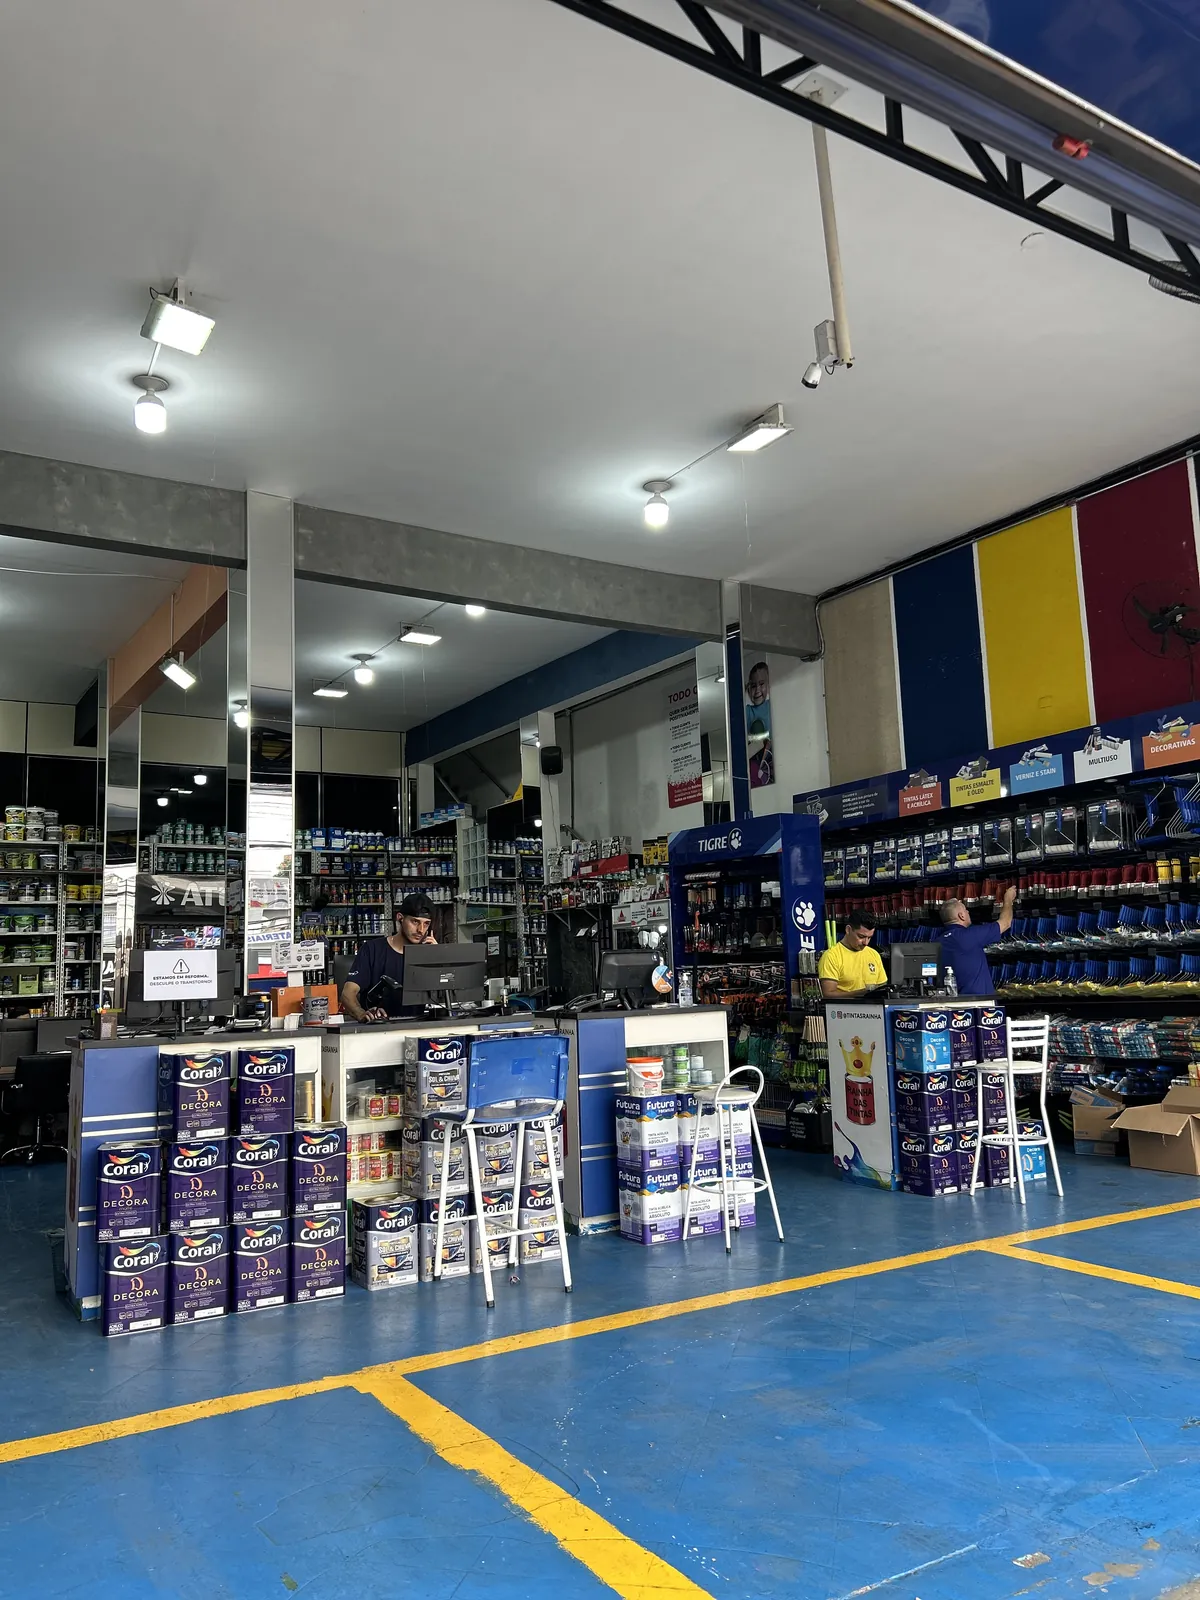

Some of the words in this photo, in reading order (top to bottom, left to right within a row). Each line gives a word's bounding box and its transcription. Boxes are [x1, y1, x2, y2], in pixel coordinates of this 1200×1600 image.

[668, 688, 691, 704] TODO
[1150, 738, 1196, 753] DECORATIVAS
[1088, 754, 1118, 765] MULTIUSO
[1015, 772, 1035, 781] VERNIZ
[1040, 767, 1056, 776] STAIN
[955, 783, 972, 793] TINTAS
[972, 779, 995, 789] ESMALTE
[971, 787, 985, 796] ÓLEO
[903, 795, 918, 803] TINTAS
[919, 792, 934, 801] LÁTEX
[910, 799, 932, 808] ACRÍLICA
[698, 836, 728, 852] TIGRE
[895, 1020, 914, 1029] Coral
[926, 1021, 944, 1030] Coral
[952, 1020, 970, 1028] Coral
[981, 1017, 1000, 1025] Coral
[425, 1049, 457, 1061] Coral
[180, 1066, 217, 1080] Coral
[244, 1063, 281, 1075] Coral
[898, 1080, 917, 1091] Coral
[955, 1079, 973, 1088] Coral
[987, 1076, 1004, 1084] Cora
[847, 1086, 873, 1096] RAINHA
[927, 1082, 945, 1091] Coral
[181, 1100, 222, 1111] DECORA
[244, 1096, 286, 1105] DECORA
[616, 1099, 640, 1110] Futura
[646, 1100, 675, 1111] Futura
[853, 1098, 867, 1107] DAS
[849, 1106, 873, 1118] TINTAS
[482, 1123, 509, 1135] Coral
[531, 1119, 556, 1129] Coal
[402, 1128, 418, 1140] Coral
[431, 1127, 460, 1140] Coal
[298, 1142, 334, 1155] Coral
[902, 1142, 922, 1152] Coral
[933, 1144, 951, 1153] Coral
[236, 1148, 273, 1161] Coral
[173, 1155, 212, 1168] Coral
[103, 1162, 143, 1176] Coral
[298, 1175, 339, 1185] DECORA
[619, 1170, 640, 1182] Futura
[647, 1173, 678, 1184] Futura
[237, 1182, 279, 1192] DECORA
[174, 1189, 217, 1199] DECORA
[103, 1198, 149, 1208] DECORA
[526, 1195, 554, 1208] Coral
[430, 1208, 460, 1221] Cral
[375, 1216, 408, 1230] Coral
[300, 1226, 335, 1241] Coral
[240, 1234, 277, 1249] Coral
[178, 1243, 216, 1259] Coral
[113, 1252, 154, 1269] Coral
[301, 1259, 340, 1271] DECORA
[241, 1268, 282, 1280] DECORA
[178, 1278, 222, 1291] DECORA
[113, 1288, 159, 1302] DECORA
